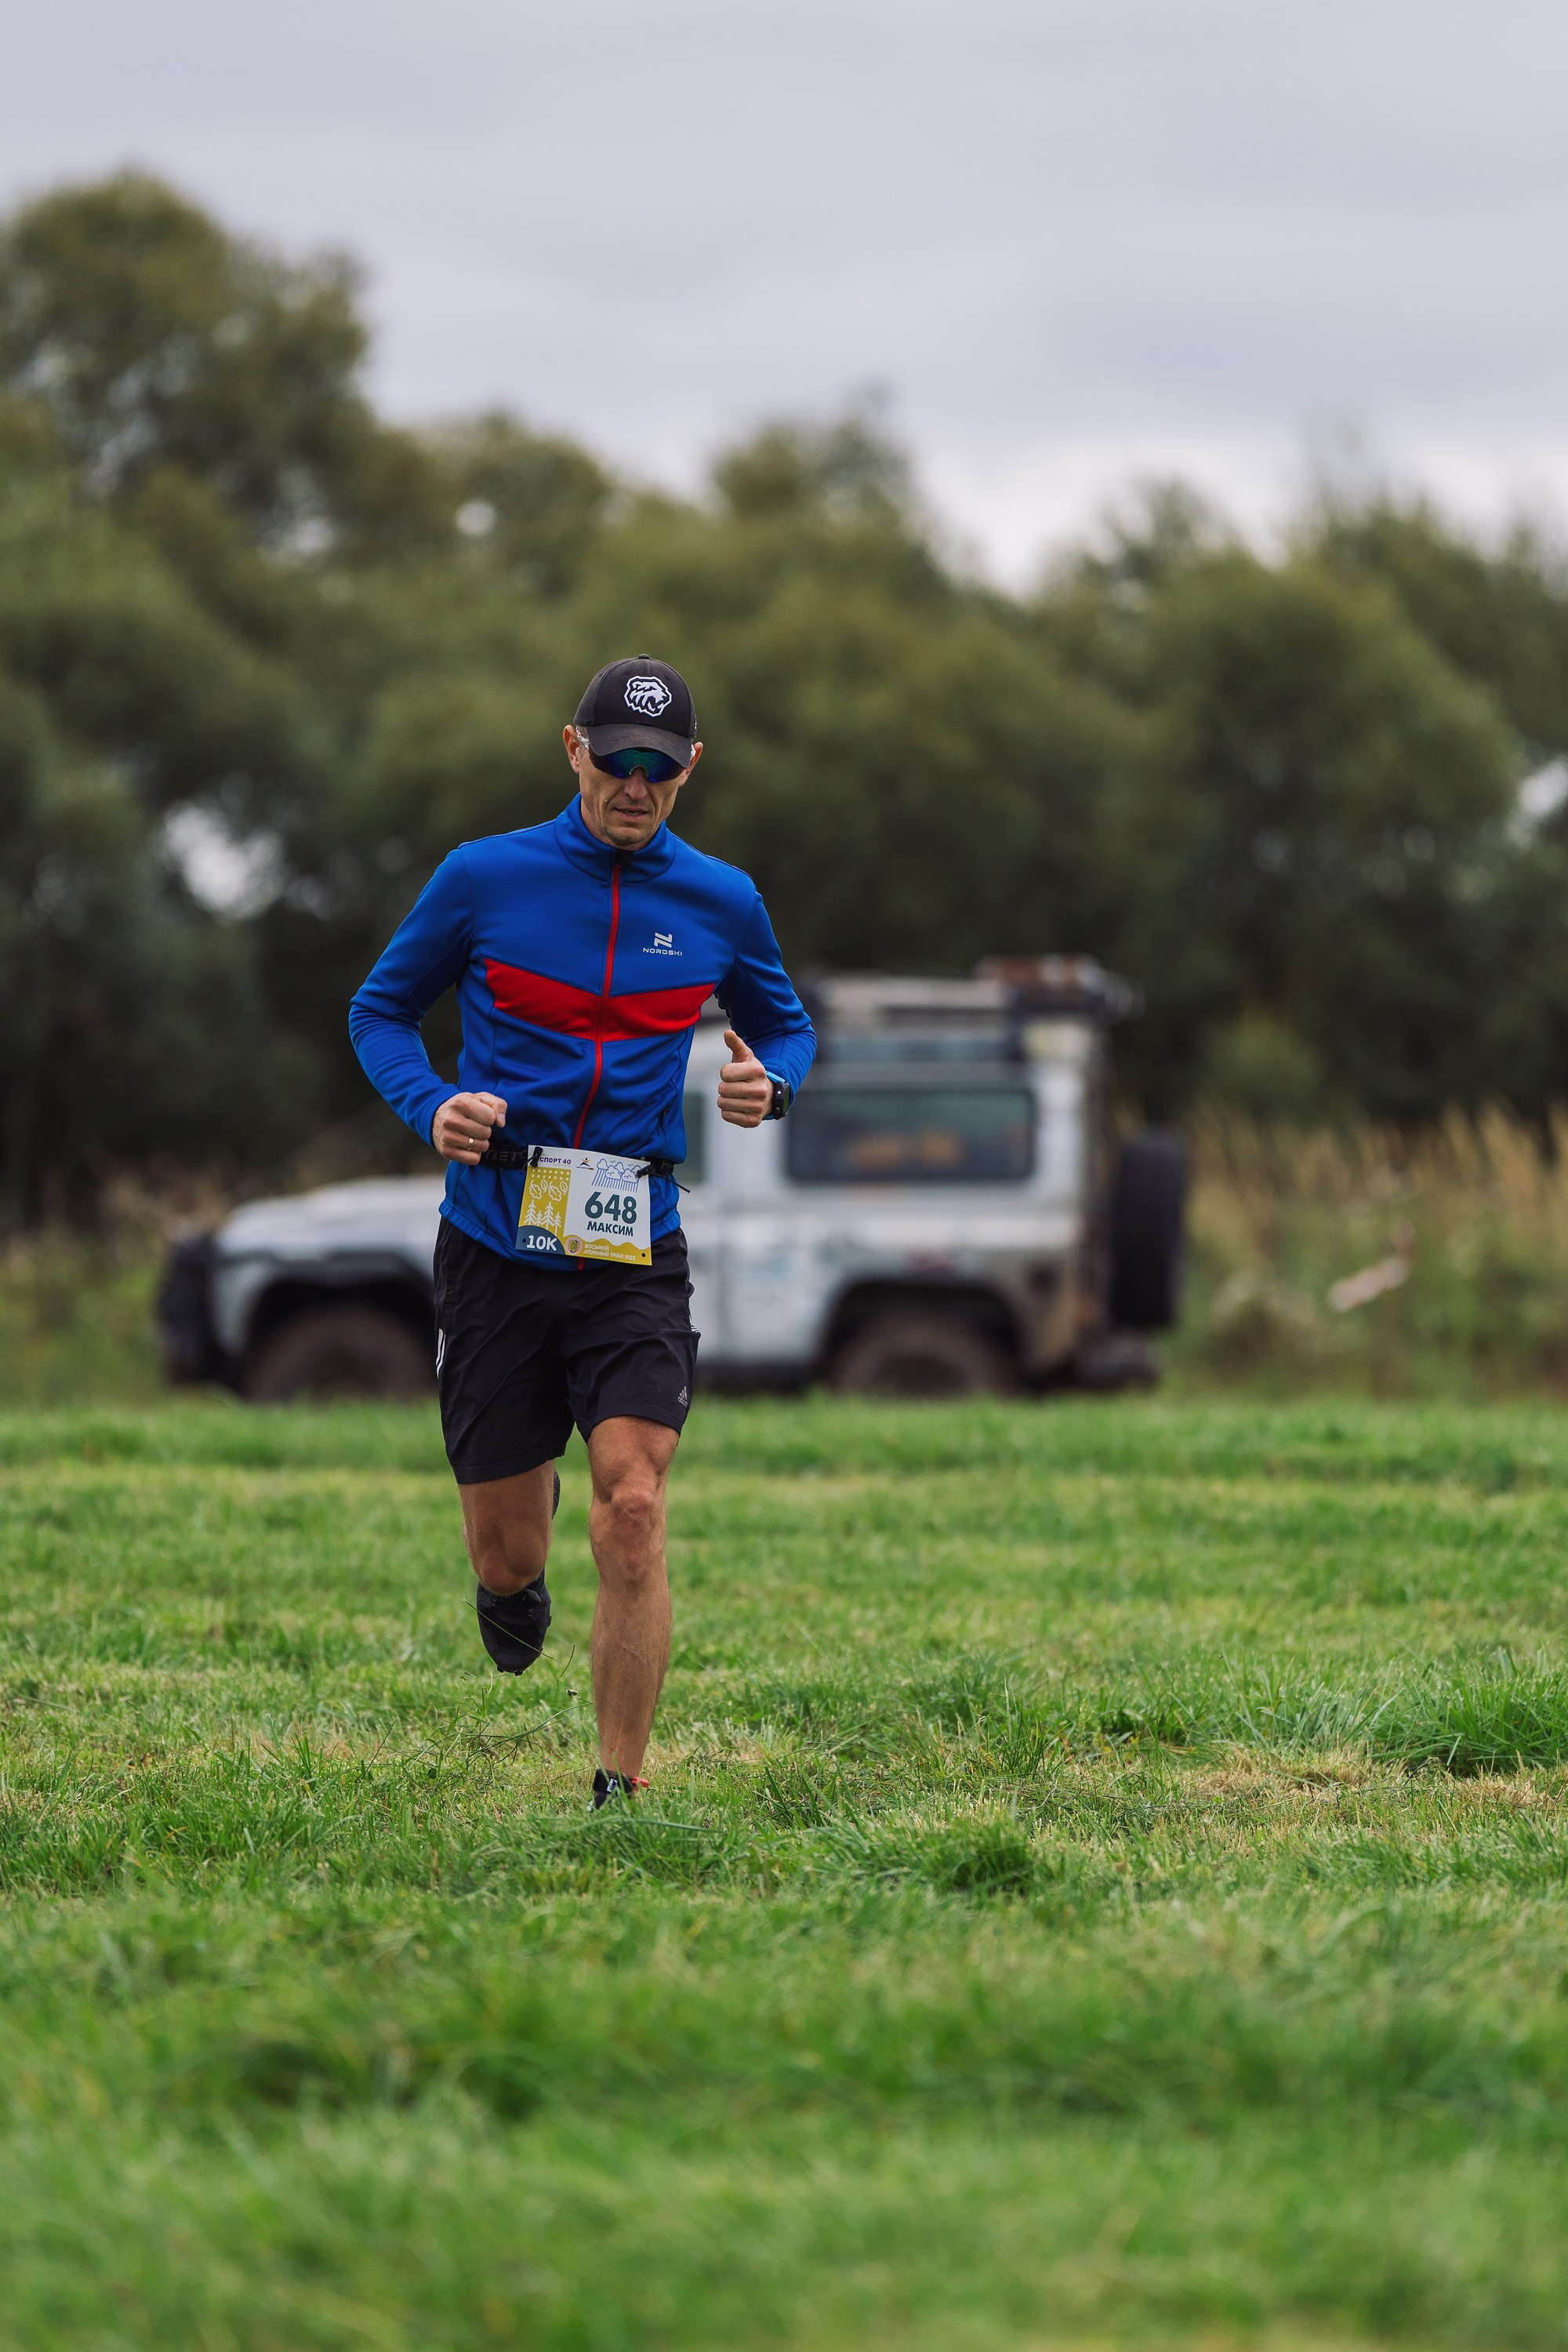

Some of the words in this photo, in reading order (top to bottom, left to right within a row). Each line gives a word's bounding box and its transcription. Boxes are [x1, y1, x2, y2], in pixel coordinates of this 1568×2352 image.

[643, 947, 682, 956] NORDSKI
[585, 1191, 637, 1225] 648
[586, 1221, 633, 1237] МАКСИМ
[526, 1235, 557, 1251] 10K
[583, 1249, 609, 1258] АТОМНЫЙ
